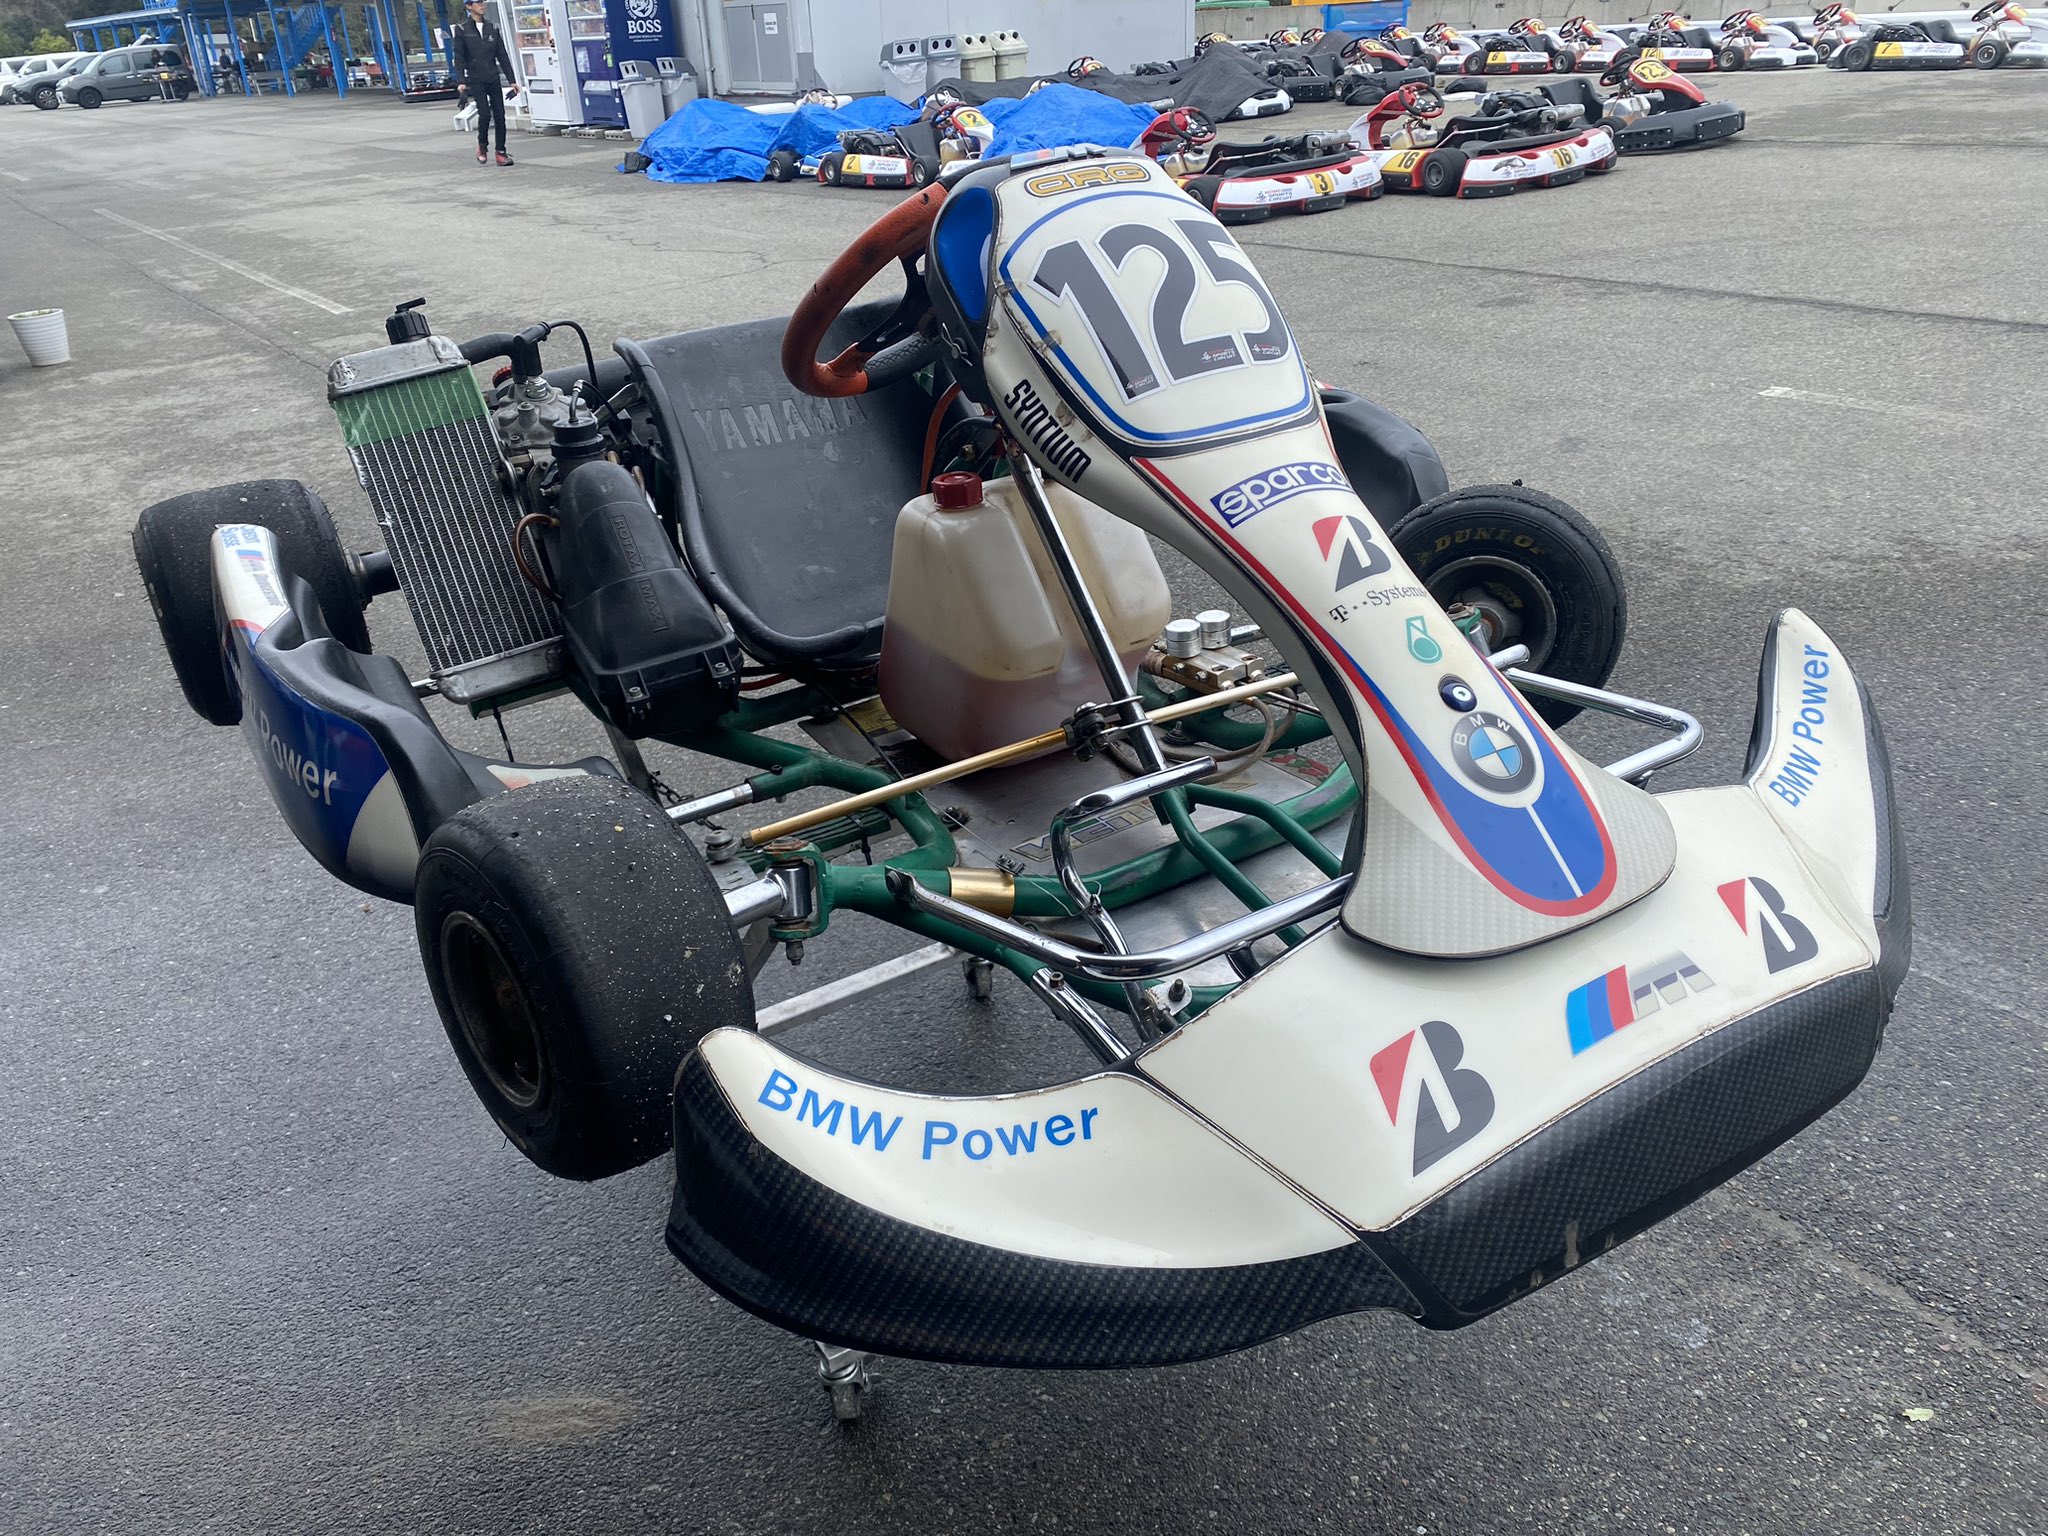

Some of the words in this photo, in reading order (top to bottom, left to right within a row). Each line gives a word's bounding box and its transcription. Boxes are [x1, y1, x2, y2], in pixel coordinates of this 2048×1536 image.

[627, 19, 662, 34] BOSS
[1881, 42, 1893, 55] 7
[1644, 48, 1658, 58] 12
[846, 155, 857, 170] 2
[1397, 151, 1420, 169] 16
[1553, 147, 1572, 167] 16
[1027, 163, 1149, 197] CRG
[1315, 173, 1329, 191] 3
[1030, 218, 1291, 401] 125
[691, 395, 868, 451] YAMAHA
[1003, 379, 1092, 484] SYNTIUM
[1219, 463, 1347, 515] sparco
[613, 519, 643, 571] ROTAX
[640, 583, 664, 627] MAX
[1792, 644, 1830, 745] Power
[1455, 713, 1510, 746] BMW
[260, 709, 338, 806] Power
[1768, 744, 1821, 808] BMW
[757, 1068, 904, 1152] BMW
[922, 1106, 1099, 1161] Power
